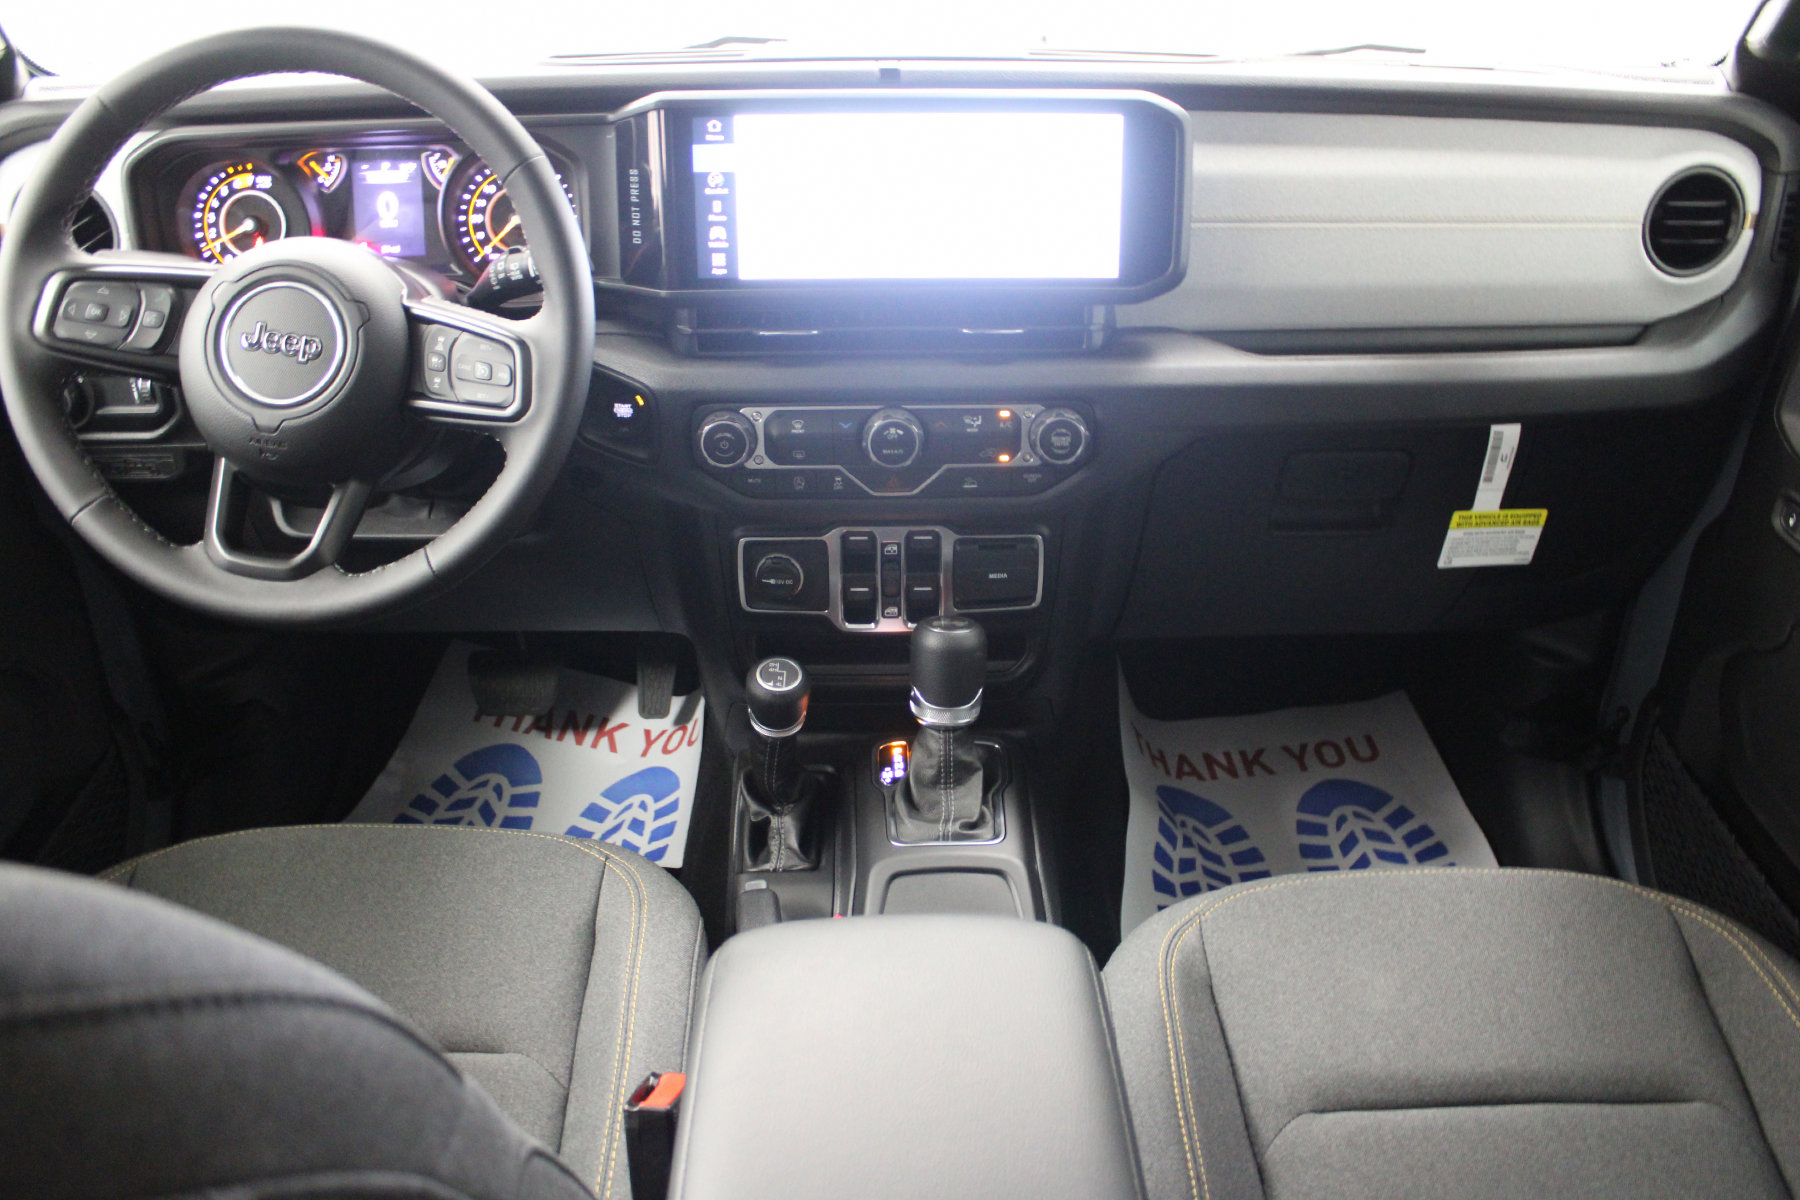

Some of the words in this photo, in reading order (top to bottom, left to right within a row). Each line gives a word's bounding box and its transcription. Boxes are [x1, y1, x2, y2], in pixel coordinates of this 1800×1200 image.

[629, 168, 640, 202] PRESS
[376, 190, 400, 221] 0
[631, 206, 641, 226] NOT
[632, 230, 642, 245] DO
[240, 320, 323, 365] Jeep
[473, 707, 629, 754] ANK
[1130, 721, 1277, 782] THANK
[1281, 733, 1381, 773] YOU
